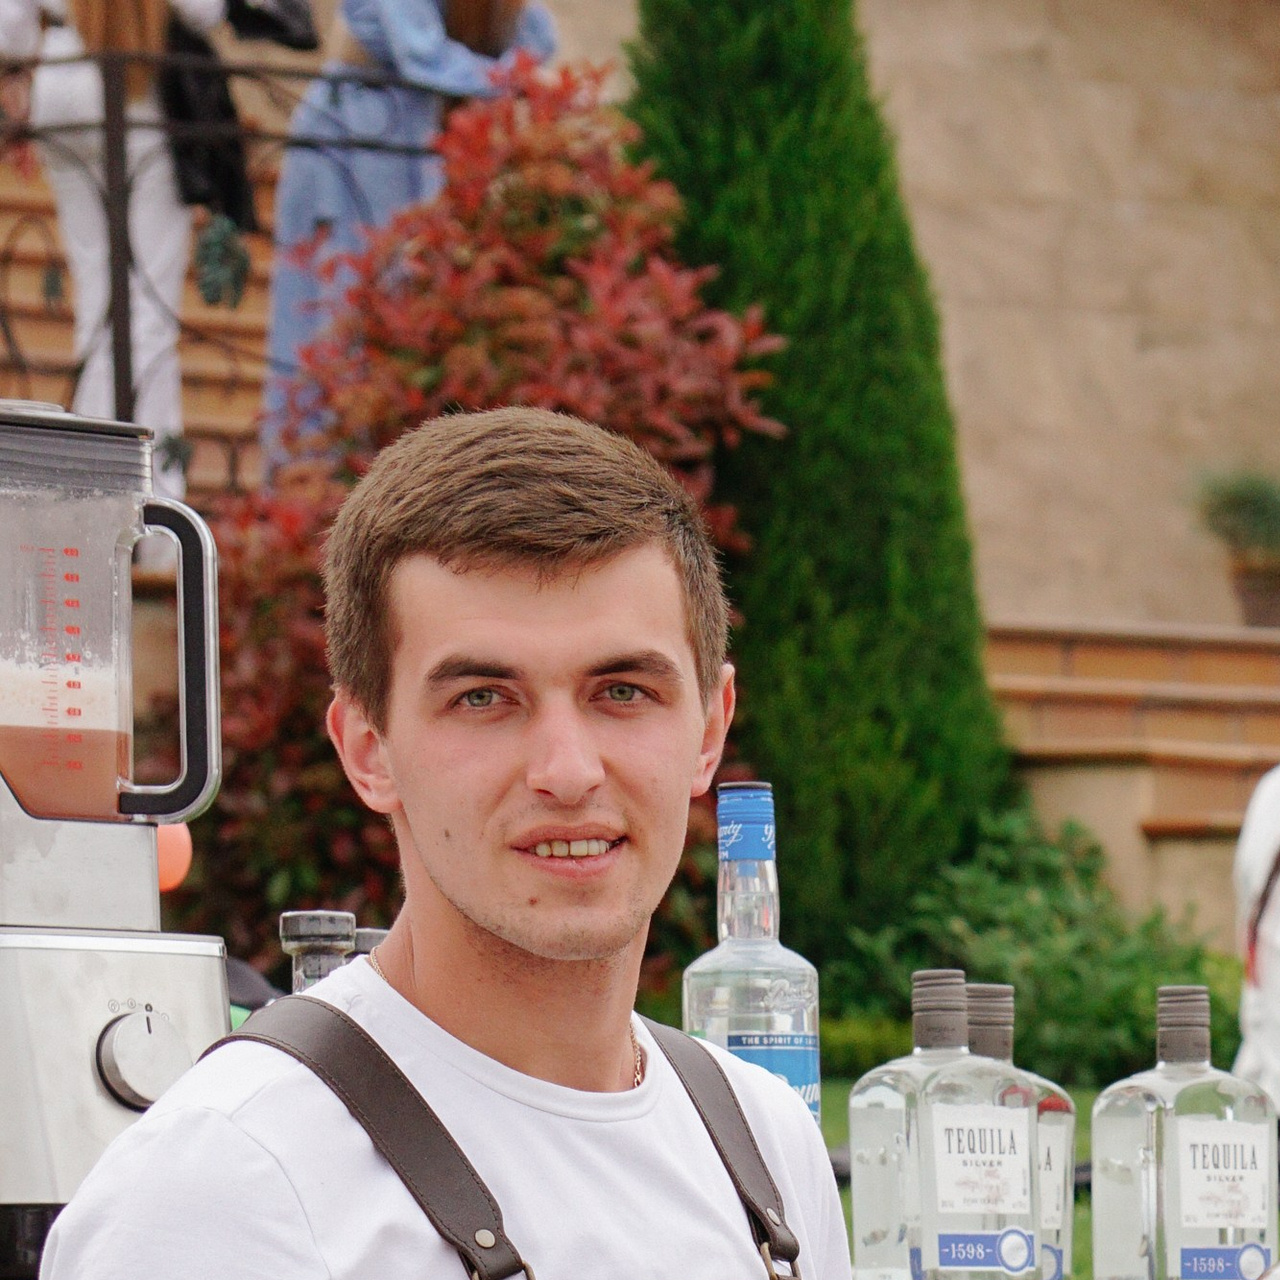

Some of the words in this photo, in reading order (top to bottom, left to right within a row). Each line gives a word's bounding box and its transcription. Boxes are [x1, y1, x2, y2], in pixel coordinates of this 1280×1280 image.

[741, 1036, 760, 1045] THE
[763, 1036, 792, 1045] SPIRIT
[944, 1128, 1017, 1155] TEQUILA
[1190, 1143, 1258, 1170] TEQUILA
[950, 1243, 985, 1260] 1598
